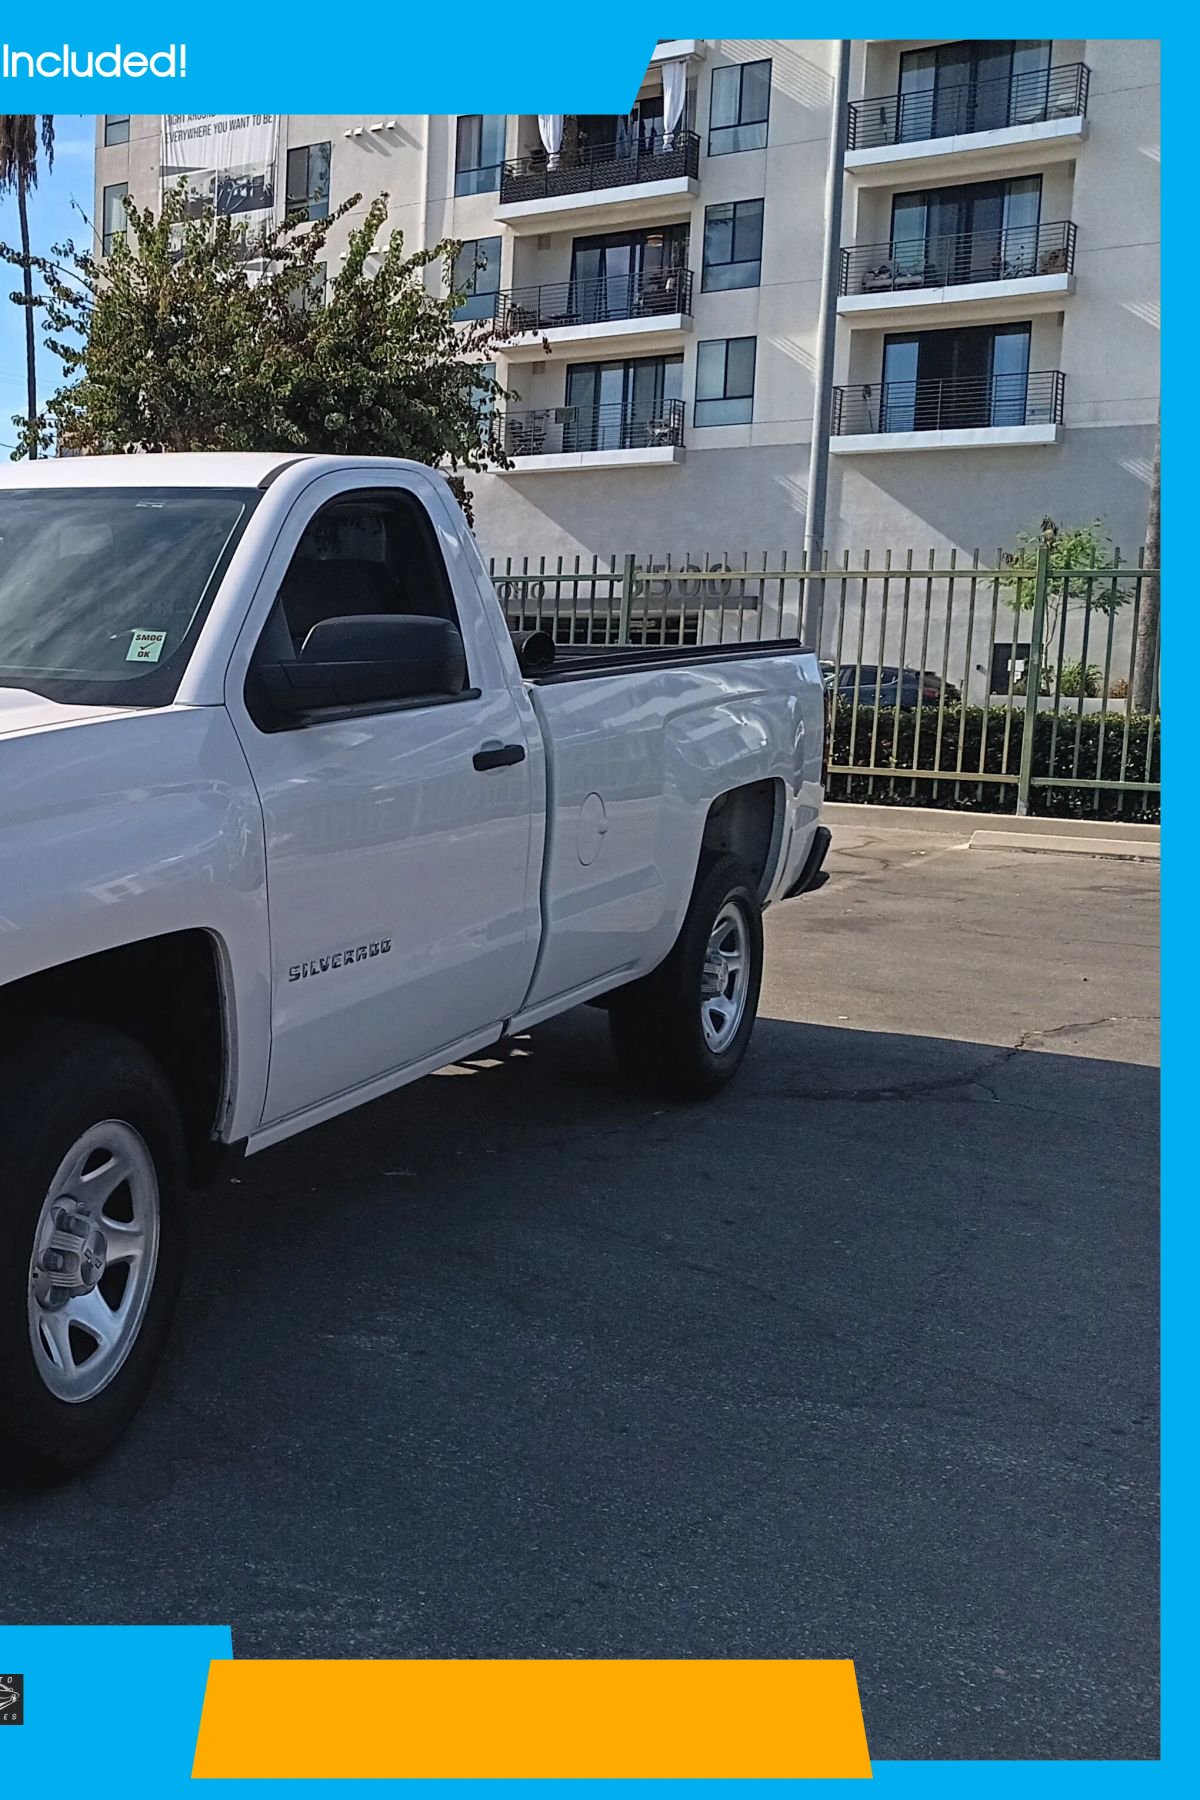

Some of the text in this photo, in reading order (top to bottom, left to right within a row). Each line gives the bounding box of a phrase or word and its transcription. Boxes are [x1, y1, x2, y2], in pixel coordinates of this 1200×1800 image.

[165, 114, 273, 144] EVERYWHERE YOU WANT TO BE
[135, 634, 163, 642] SMOG
[288, 939, 392, 982] SILVERADO
